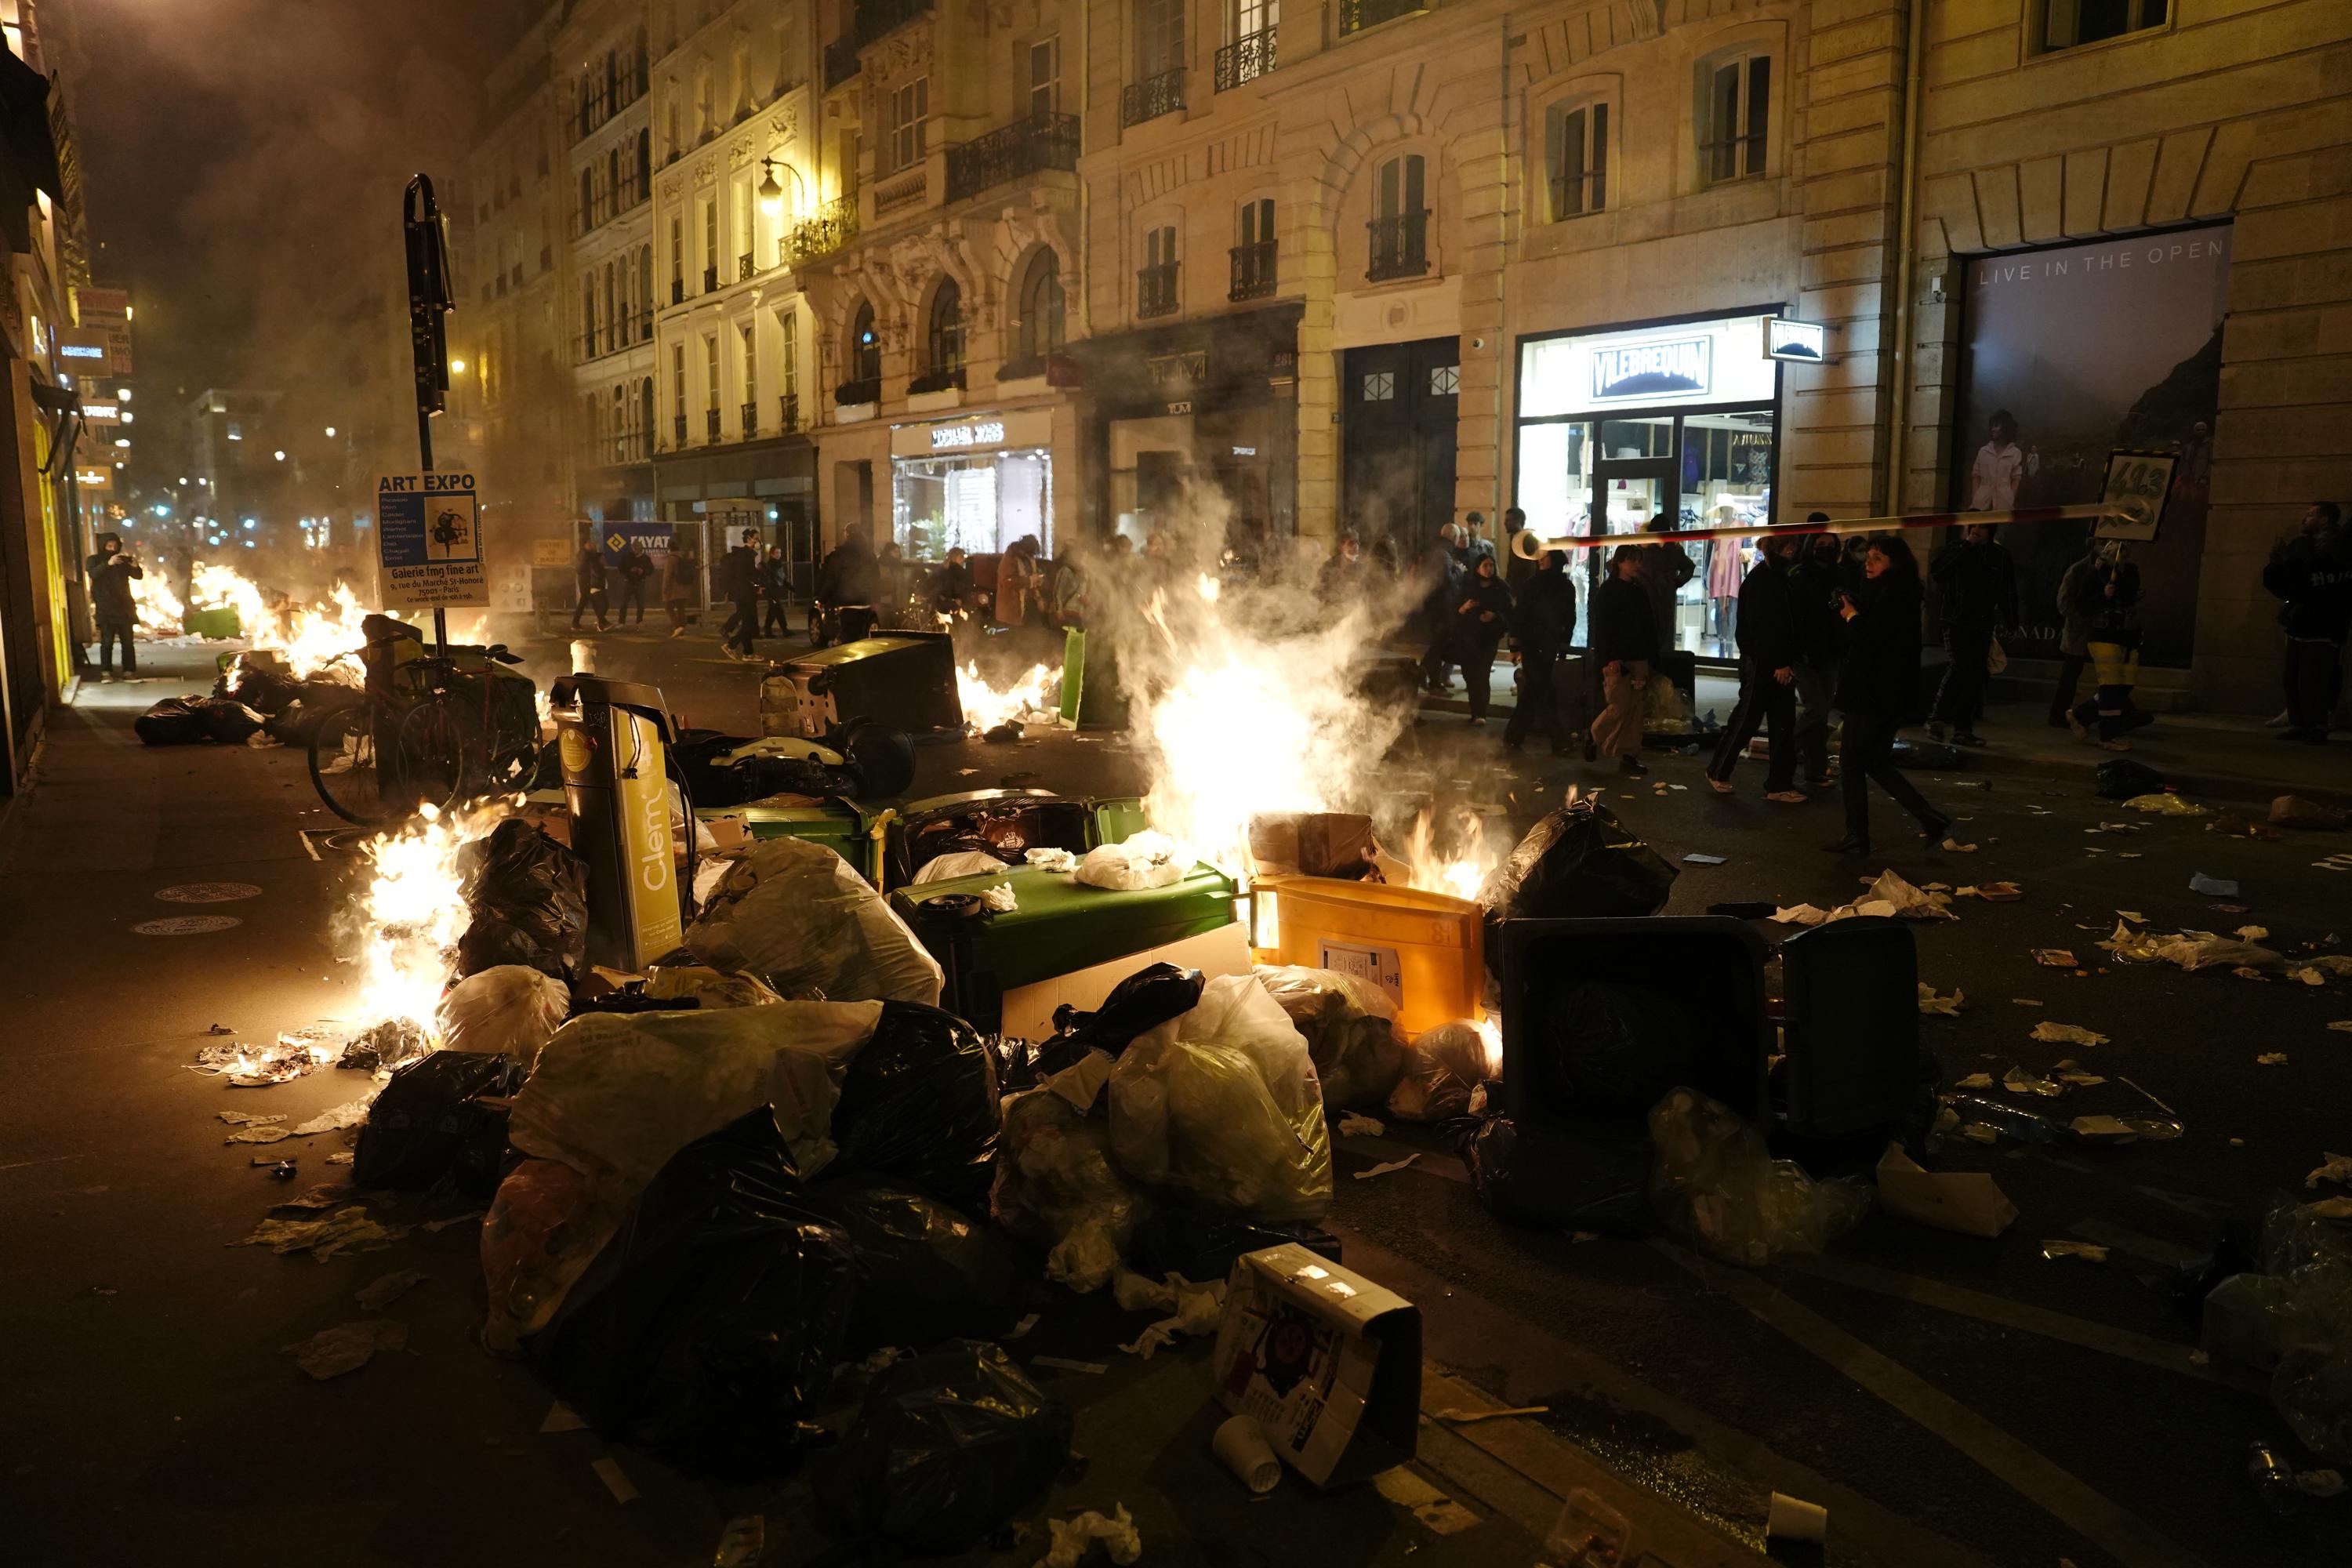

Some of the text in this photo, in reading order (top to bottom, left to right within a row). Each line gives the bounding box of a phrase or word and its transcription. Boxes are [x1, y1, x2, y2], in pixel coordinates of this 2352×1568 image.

[1980, 239, 2223, 285] LIVE IN THE OPEN
[1592, 339, 1706, 397] VILEBREQUIN
[1167, 401, 1192, 415] TUMI
[378, 474, 475, 492] ART EXPO
[392, 564, 479, 579] Galerie fmg fine art
[423, 578, 448, 587] Marché
[449, 577, 484, 586] St-Honoré
[419, 588, 438, 597] 75001
